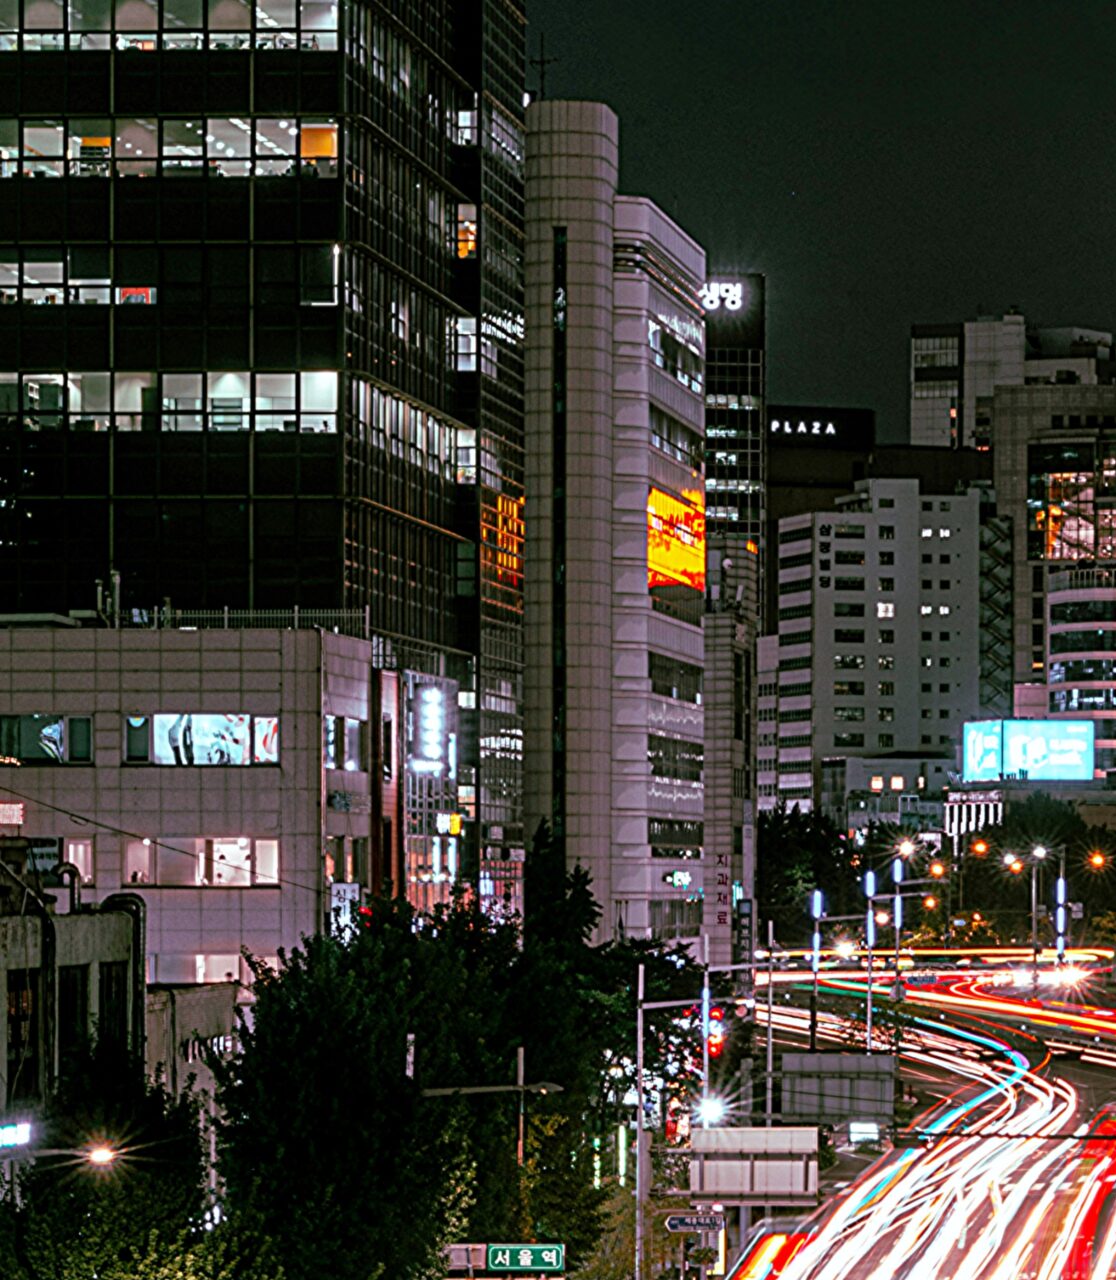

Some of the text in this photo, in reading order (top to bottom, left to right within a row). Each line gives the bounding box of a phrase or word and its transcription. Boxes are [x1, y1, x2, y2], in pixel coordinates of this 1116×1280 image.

[698, 282, 742, 310] 생명
[771, 420, 836, 434] PLAZA
[494, 1250, 557, 1267] 서울역
